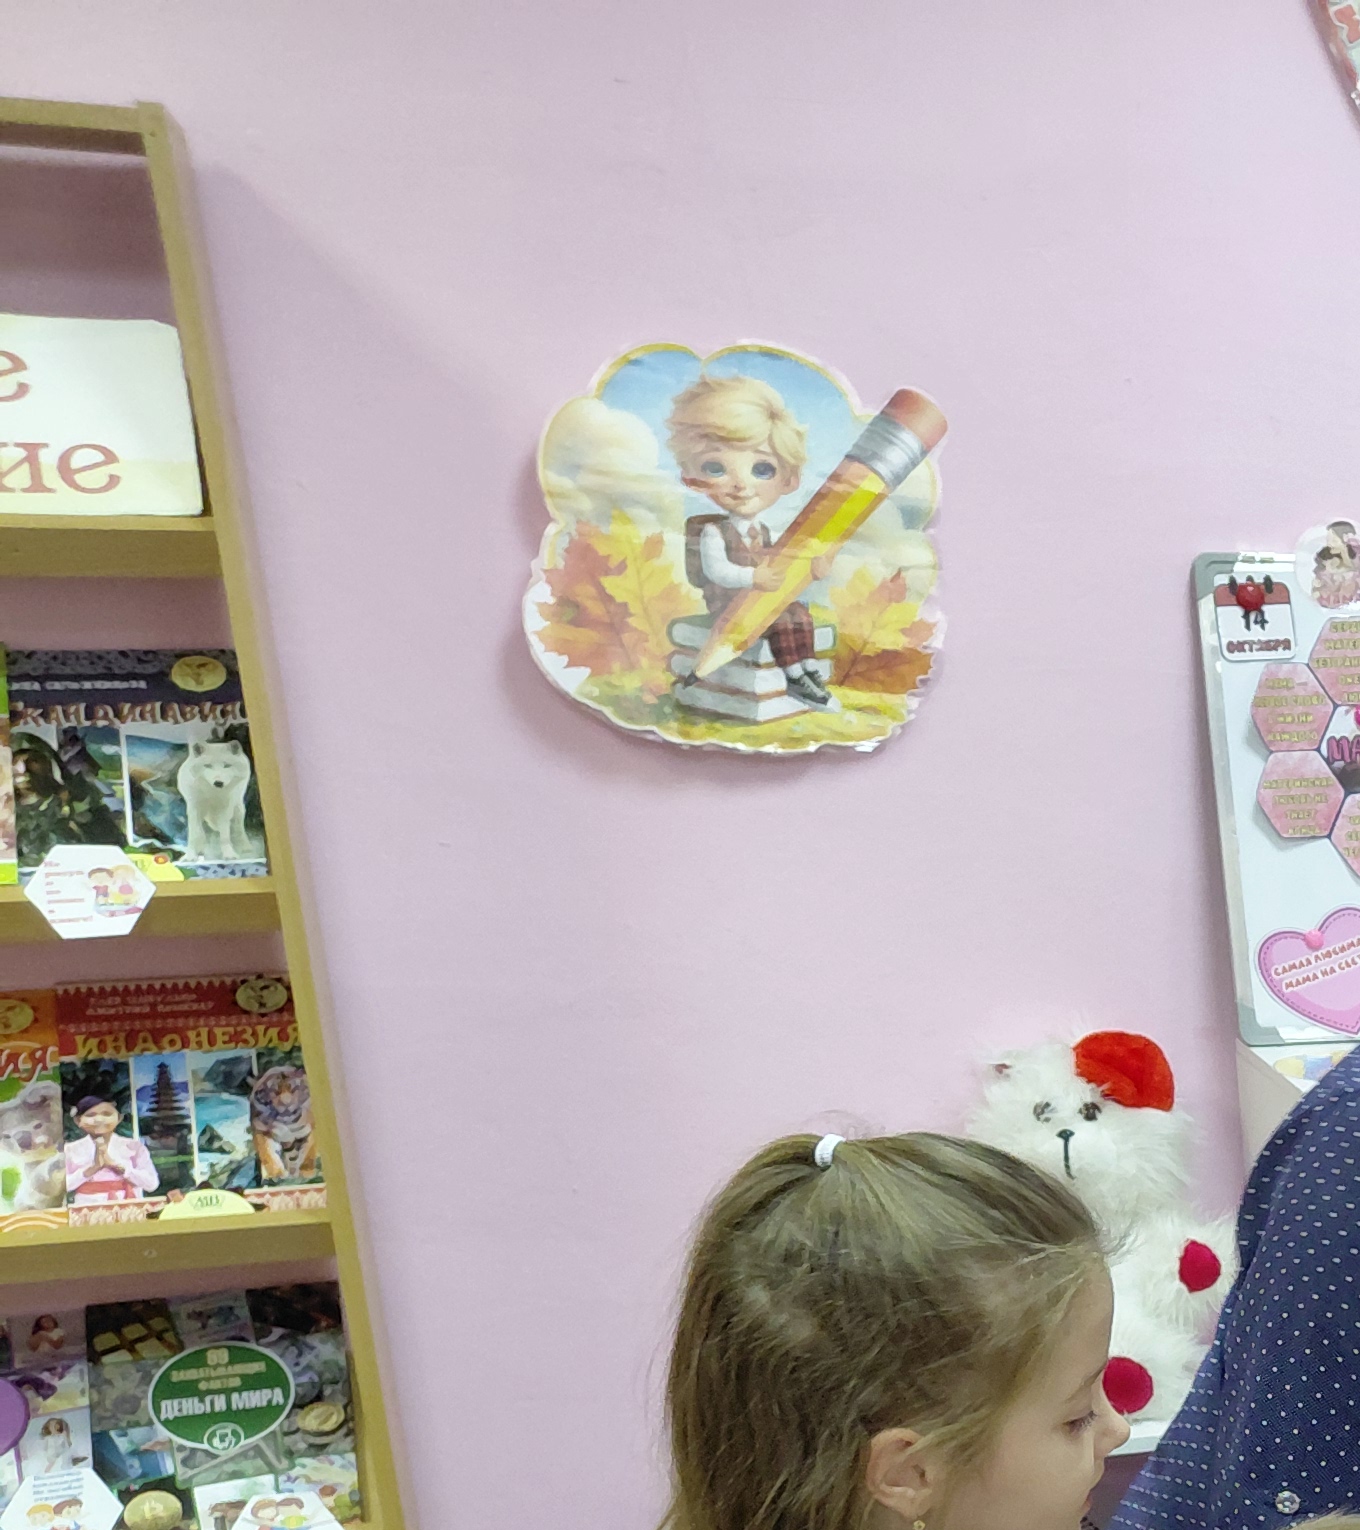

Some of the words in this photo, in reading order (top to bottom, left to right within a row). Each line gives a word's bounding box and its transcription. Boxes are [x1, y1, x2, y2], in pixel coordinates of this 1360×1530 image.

[1241, 608, 1269, 632] 14
[1273, 957, 1313, 977] САМАЯ
[1284, 972, 1320, 991] МАМА
[1320, 965, 1337, 978] НА
[74, 1023, 300, 1060] ИНДОНЕЗИЯ
[160, 1394, 227, 1421] ДЕНЬГИ
[231, 1387, 284, 1411] МИРА
